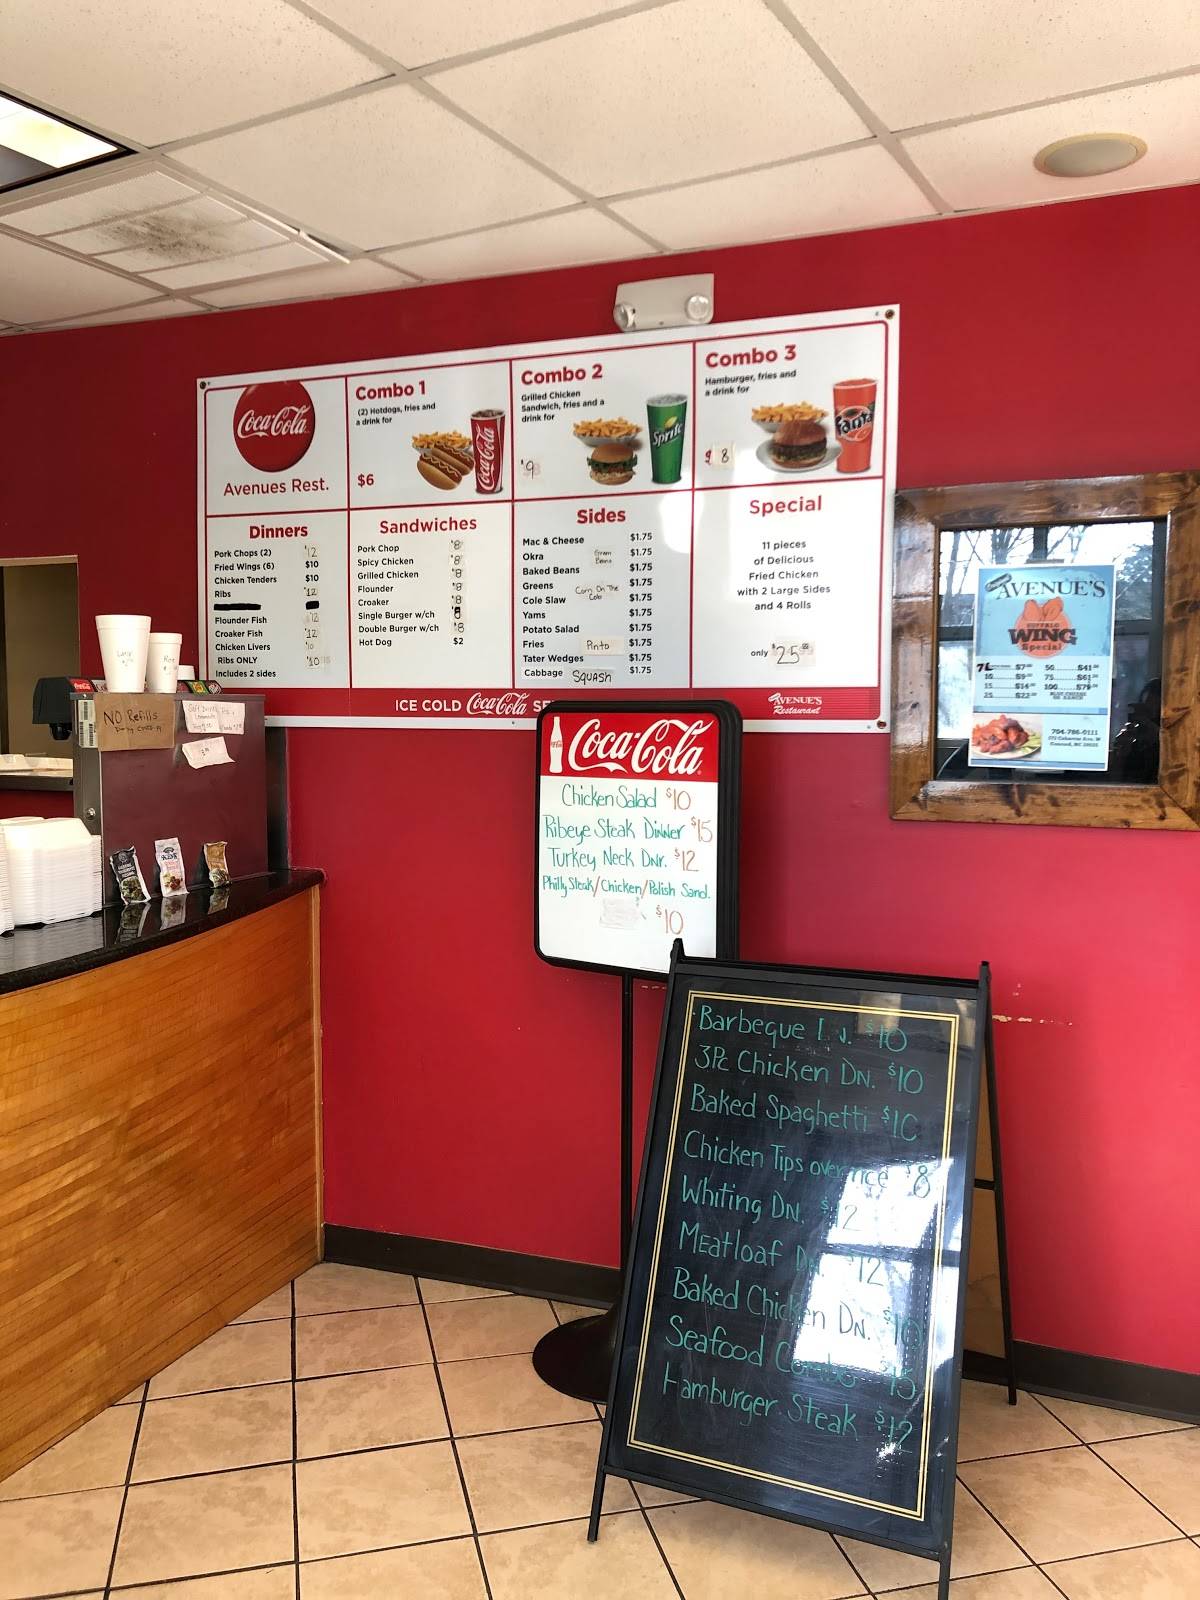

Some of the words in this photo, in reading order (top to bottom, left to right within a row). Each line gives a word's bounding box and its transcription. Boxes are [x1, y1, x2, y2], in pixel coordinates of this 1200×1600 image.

[706, 348, 778, 368] Combo
[785, 344, 797, 360] 3
[521, 366, 586, 385] Combo
[592, 364, 603, 379] 2
[705, 375, 755, 385] Hamburger,
[758, 372, 777, 380] fries
[780, 370, 797, 378] and
[356, 383, 414, 400] Combo
[419, 380, 425, 395] 1
[522, 393, 547, 401] Grilled
[549, 390, 581, 399] Chicken
[358, 408, 368, 416] (2)
[370, 406, 402, 415] Hotdogs,
[522, 403, 561, 412] Sandwich,
[563, 401, 580, 409] fries
[238, 405, 311, 438] Coca-Cola
[835, 412, 873, 435] Fanta
[652, 424, 683, 446] Sprite
[358, 474, 374, 488] $6
[224, 482, 286, 496] Avenues
[292, 478, 329, 492] Rest.
[749, 495, 822, 517] Special
[577, 508, 626, 524] Sides
[380, 517, 477, 534] Sandwiches
[249, 526, 308, 539] Dinners
[630, 533, 652, 541] $1.75
[523, 538, 540, 546] Mac
[762, 542, 770, 550] 11
[773, 541, 806, 551] pieces
[234, 549, 257, 557] Chops
[260, 549, 272, 557] (2)
[630, 548, 652, 556] $1.75
[382, 558, 414, 566] Chicken
[754, 557, 764, 565] of
[768, 555, 814, 565] Delicious
[553, 567, 579, 575] Beans
[630, 563, 653, 571] $1.75
[386, 571, 419, 579] Chicken
[749, 572, 775, 581] Fried
[779, 570, 819, 580] Chicken
[523, 582, 553, 590] Greens
[630, 578, 652, 586] $1.75
[737, 587, 758, 596] with
[771, 587, 799, 597] Large
[803, 585, 831, 594] Sides
[996, 581, 1105, 600] AVENUE'S
[523, 597, 542, 605] Cole
[630, 594, 652, 602] $1.75
[754, 602, 773, 610] and
[786, 601, 811, 610] Rolls
[359, 612, 382, 621] Single
[385, 612, 412, 620] Burger
[415, 611, 435, 619] w/ch
[629, 609, 652, 617] $1.75
[389, 625, 416, 633] Burger
[419, 624, 439, 632] w/ch
[523, 626, 552, 634] Potato
[555, 625, 579, 633] Salad
[629, 624, 652, 632] $1.75
[1008, 629, 1077, 645] WING
[376, 639, 392, 647] Dog
[586, 640, 609, 651] Pinto
[629, 639, 652, 647] $1.75
[1022, 642, 1062, 652] Special
[523, 655, 544, 663] Tater
[549, 655, 584, 663] Wedges
[629, 654, 651, 662] $1.75
[751, 649, 768, 658] only
[525, 669, 563, 677] Cabbage
[395, 699, 417, 711] ICE
[422, 700, 461, 712] COLD
[466, 692, 530, 715] Coca-Cola
[774, 705, 820, 714] Restaurant
[104, 711, 122, 725] NO
[127, 709, 158, 722] Refills
[568, 719, 714, 776] Coca-Cola
[562, 784, 614, 807] Chicken
[616, 785, 657, 808] Salad
[666, 787, 691, 811] $10
[542, 815, 592, 845] Ribeye
[594, 818, 635, 839] Steak
[691, 817, 713, 843] $15
[548, 847, 596, 871] Turkey
[603, 847, 634, 867] Neck
[675, 849, 699, 872] $12
[656, 905, 683, 935] $10
[699, 1005, 805, 1048] Barbeque
[738, 1050, 829, 1084] Chicken
[888, 1062, 924, 1094] $10
[690, 1083, 757, 1119] Baked
[766, 1095, 868, 1135] Spaghetti
[683, 1130, 764, 1168] Chicken
[771, 1144, 804, 1182] Tips
[681, 1175, 762, 1224] Whiting
[672, 1266, 740, 1310] Baked
[665, 1315, 764, 1368] Seafood
[662, 1361, 778, 1426] Hamburger
[787, 1394, 858, 1441] Steak
